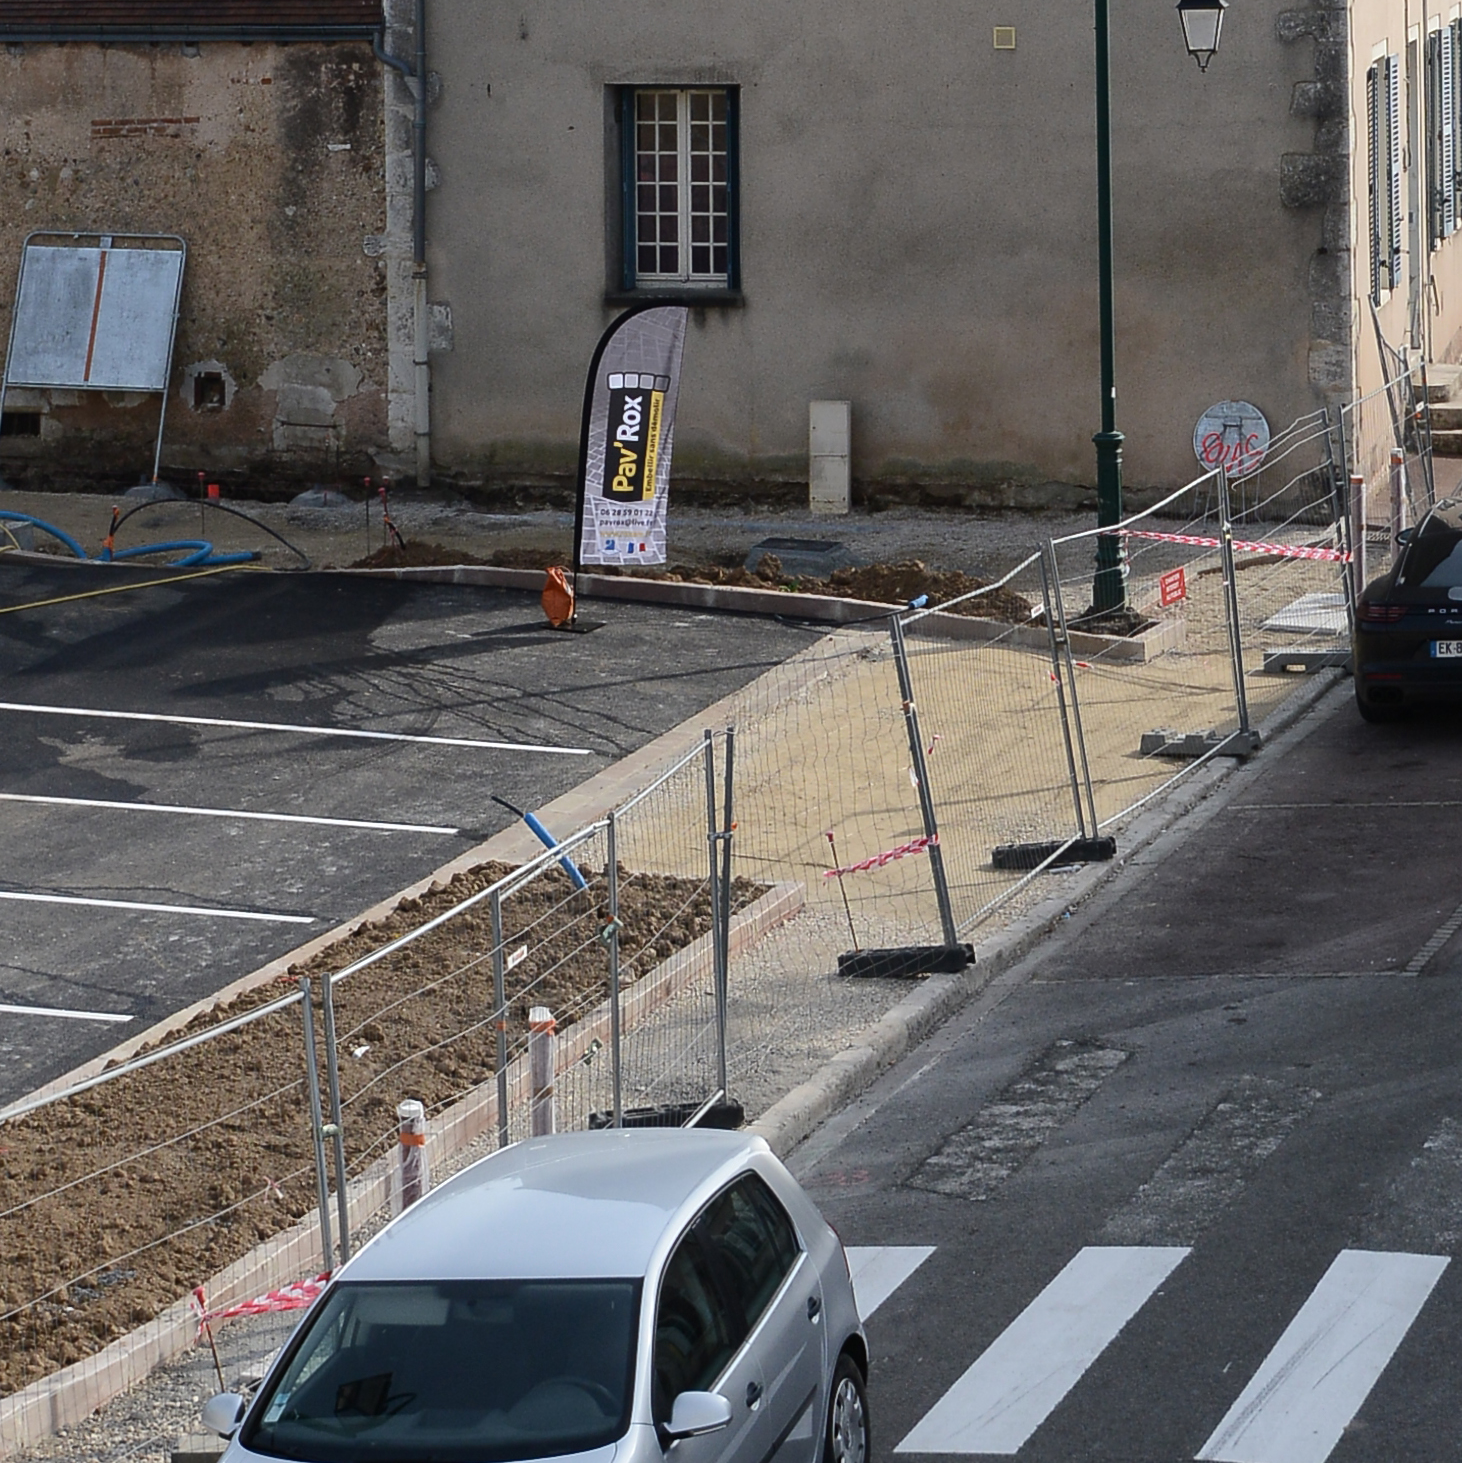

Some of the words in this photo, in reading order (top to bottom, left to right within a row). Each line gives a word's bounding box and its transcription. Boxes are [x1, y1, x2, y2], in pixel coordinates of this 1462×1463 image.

[612, 395, 643, 492] Pav'Rox
[649, 433, 657, 455] sans
[645, 455, 655, 493] Embellir
